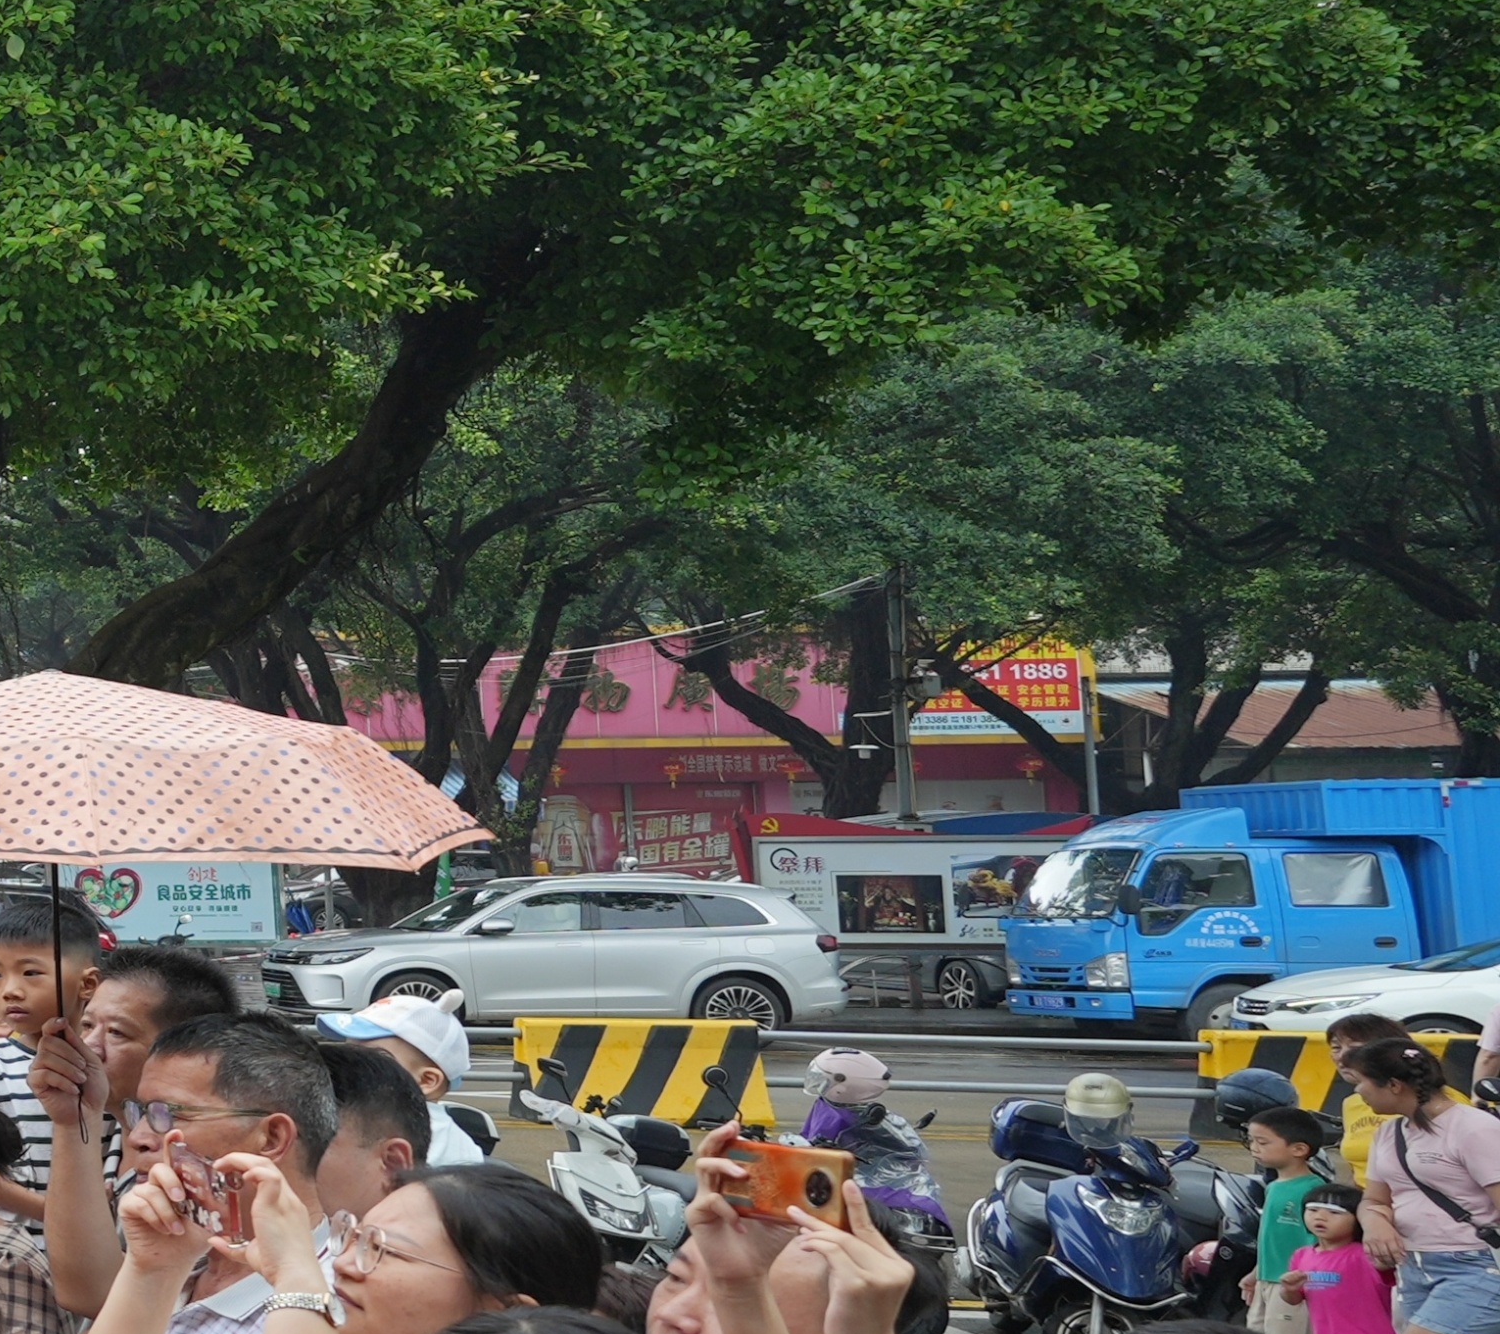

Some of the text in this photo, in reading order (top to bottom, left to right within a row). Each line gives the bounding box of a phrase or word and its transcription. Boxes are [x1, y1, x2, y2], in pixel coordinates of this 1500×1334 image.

[1010, 663, 1067, 679] 1886
[618, 831, 731, 865] 国有金罐
[778, 856, 825, 874] 祭拜
[156, 884, 252, 901] 食品安全城市
